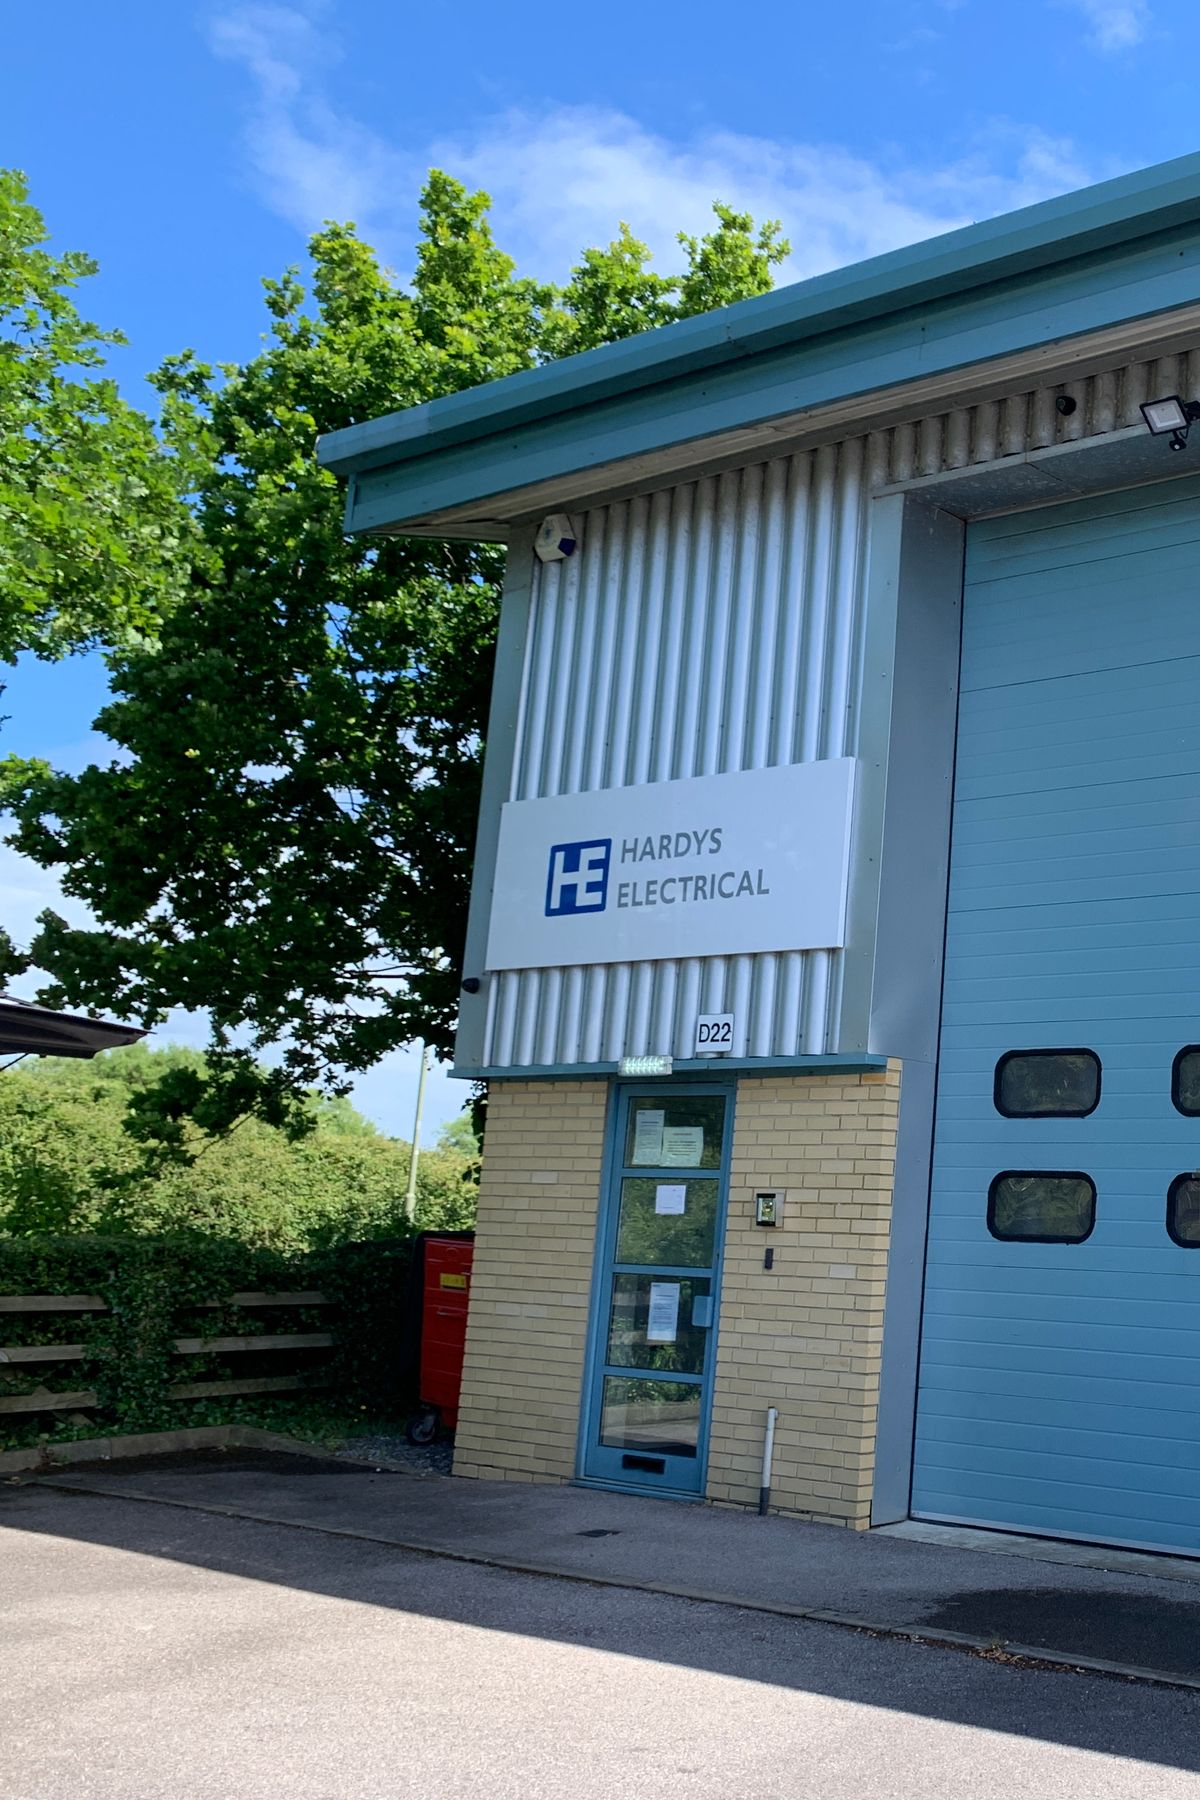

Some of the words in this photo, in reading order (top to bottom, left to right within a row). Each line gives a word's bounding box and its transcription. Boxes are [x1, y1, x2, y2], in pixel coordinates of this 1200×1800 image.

[620, 828, 723, 864] HARDYS
[616, 868, 770, 908] ELECTRICAL
[698, 1022, 731, 1043] D22
